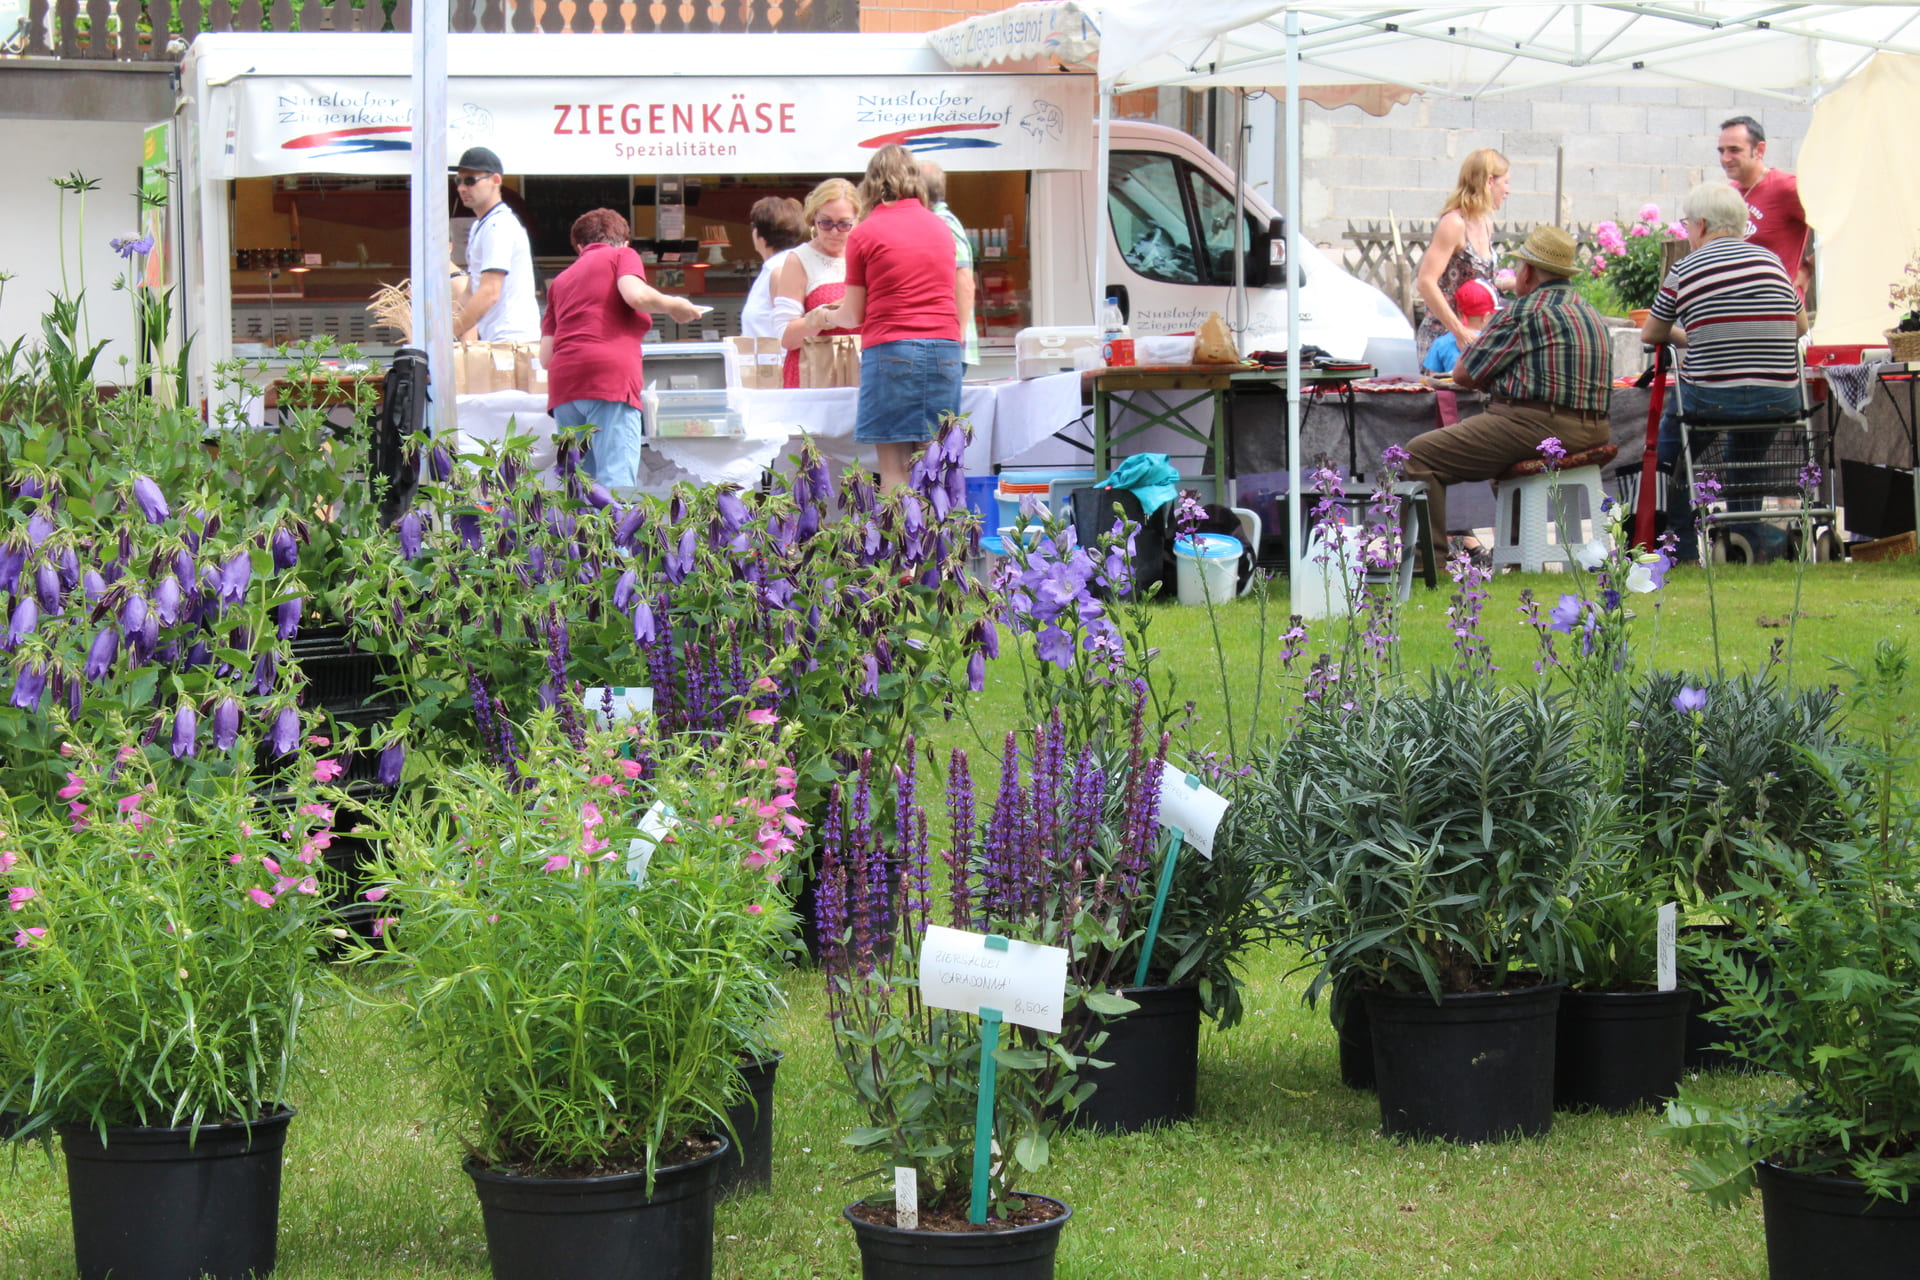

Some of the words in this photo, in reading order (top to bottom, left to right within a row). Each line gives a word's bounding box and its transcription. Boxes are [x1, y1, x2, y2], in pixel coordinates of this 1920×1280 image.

[966, 13, 1044, 57] Ziegenkäsehof
[277, 91, 400, 108] Nußlocher
[857, 90, 973, 106] Nußlocher
[553, 93, 797, 135] ZIEGENKÄSE
[857, 105, 1013, 126] Ziegenkäsehof
[615, 141, 738, 159] Spezialitäten
[1136, 305, 1213, 319] Nußloche
[1014, 998, 1049, 1016] 8,50€
